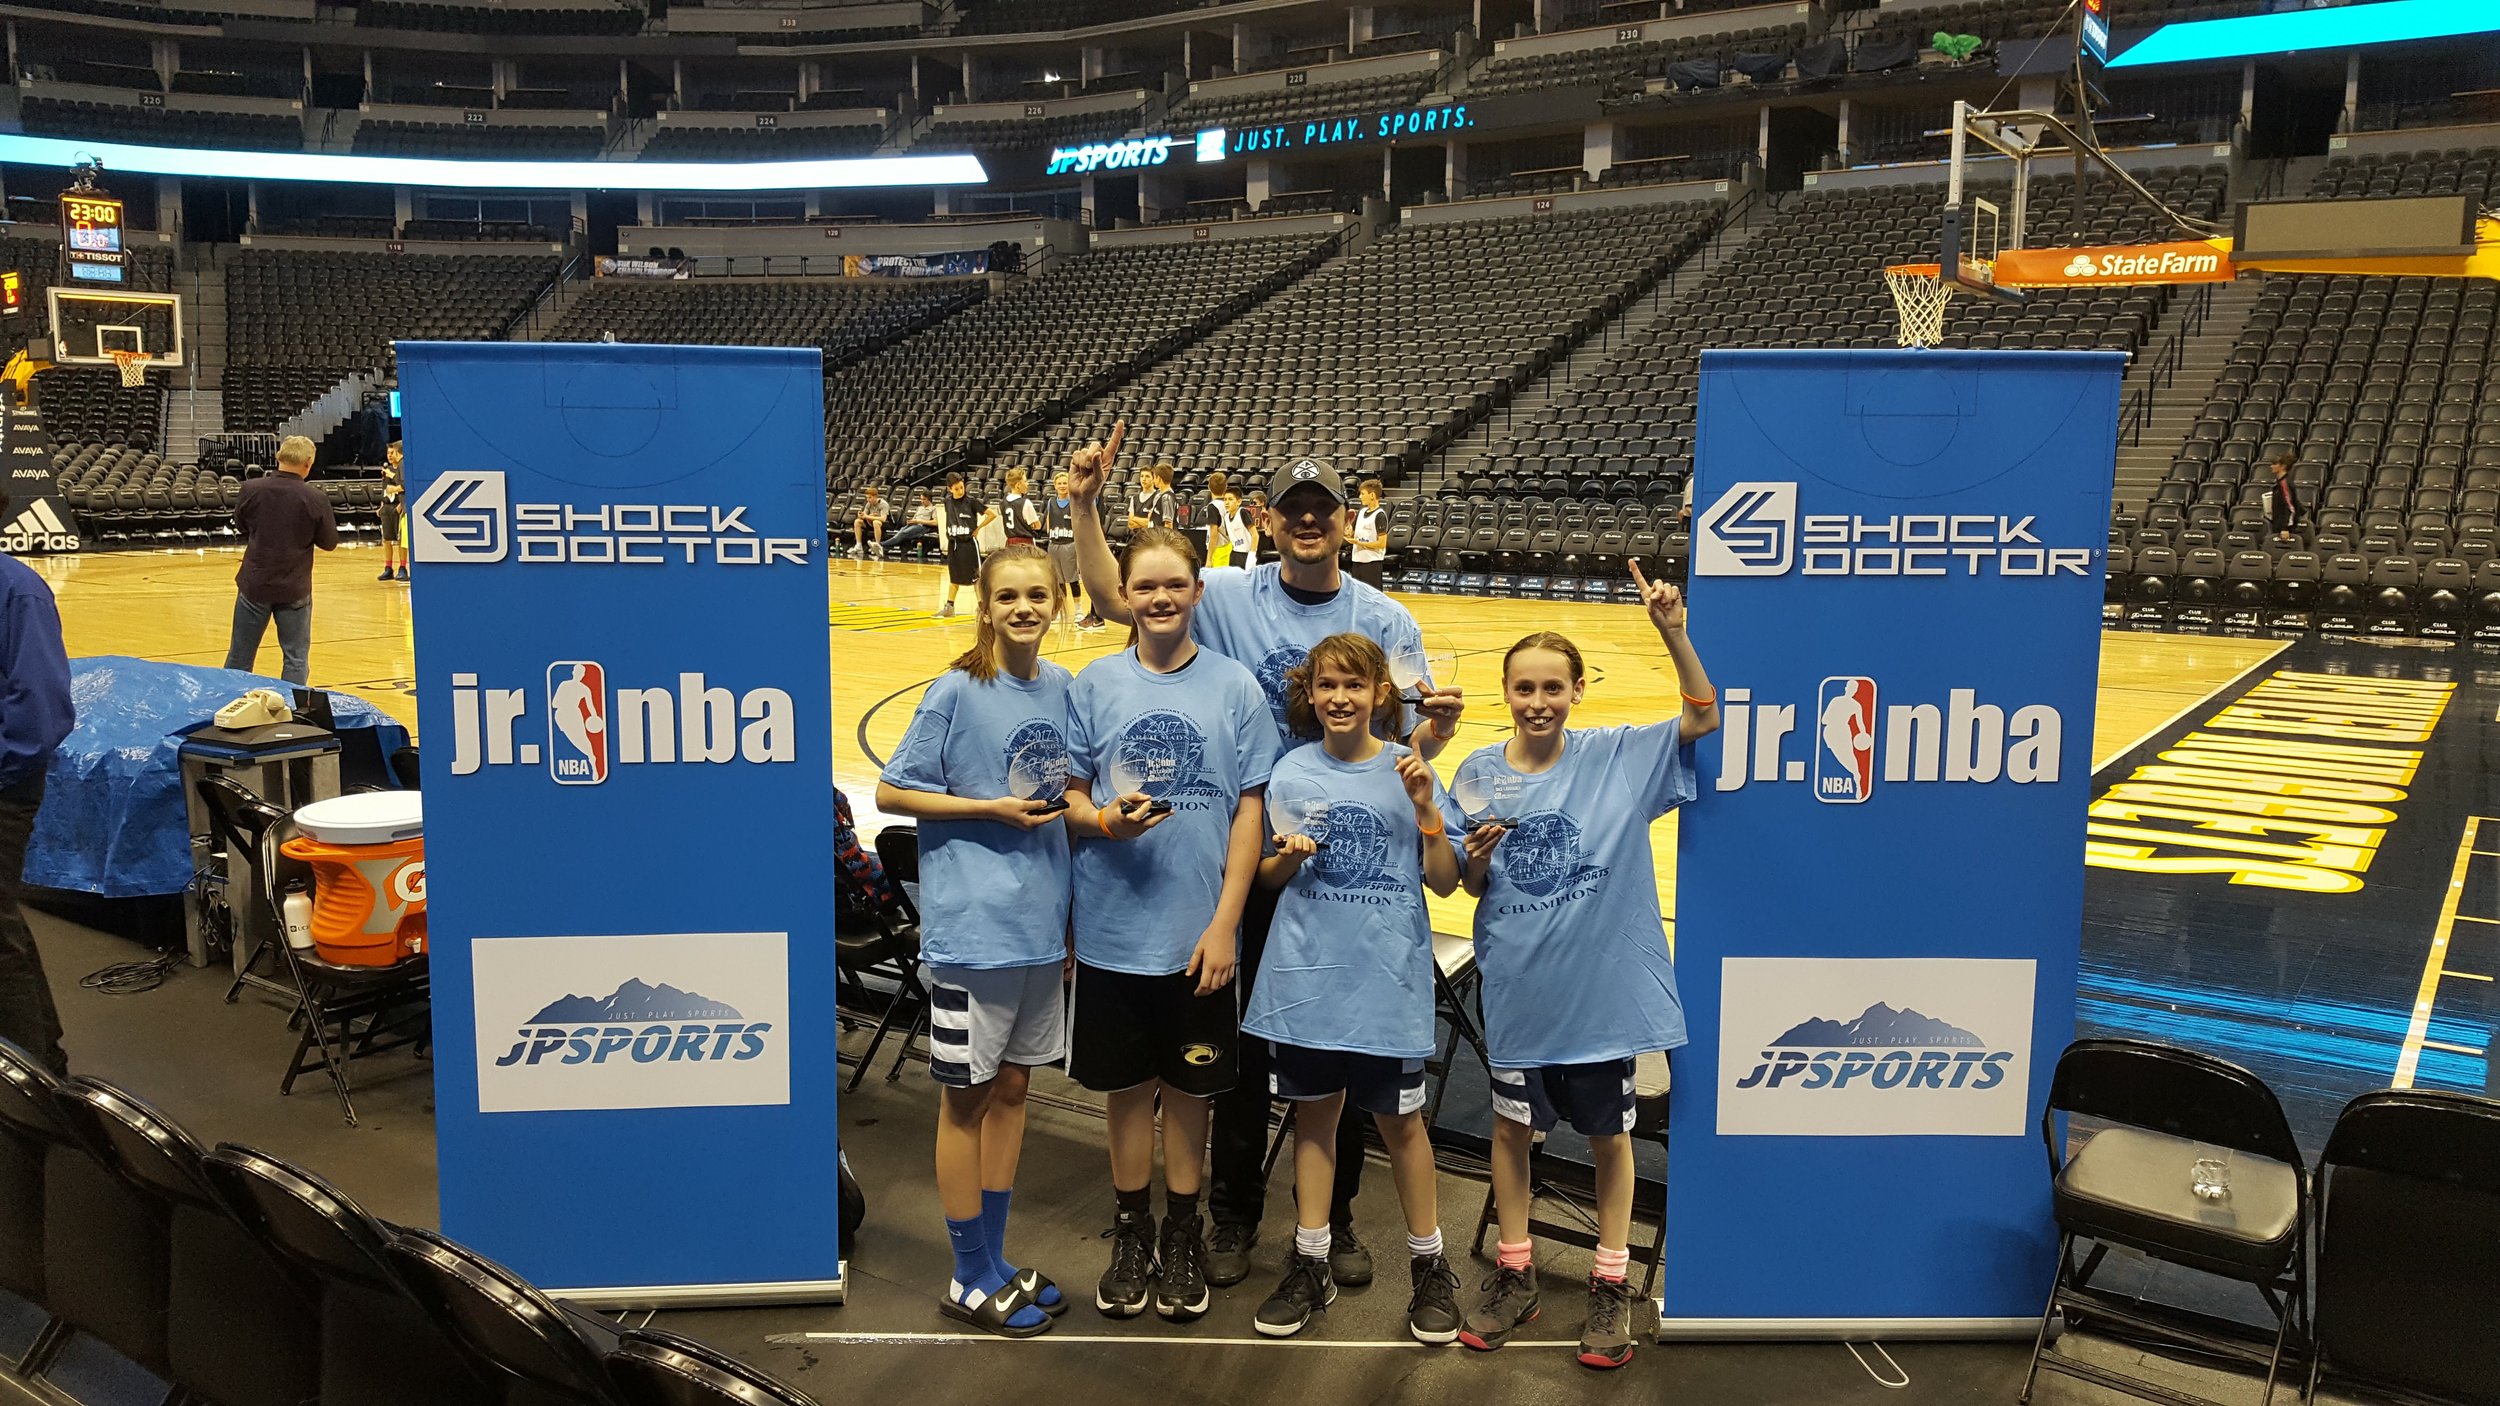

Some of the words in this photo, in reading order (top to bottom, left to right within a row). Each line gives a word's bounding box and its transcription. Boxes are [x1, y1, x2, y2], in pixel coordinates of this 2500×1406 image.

[1620, 30, 1638, 40] 230
[1289, 74, 1303, 84] 228
[143, 95, 161, 105] 220
[1027, 107, 1042, 115] 226
[759, 117, 774, 125] 224
[1234, 126, 1291, 153] JUST.
[1304, 119, 1365, 145] PLAY.
[1379, 105, 1476, 138] SPORTS.
[1046, 136, 1173, 176] JPSPORTS
[1536, 201, 1550, 209] 124
[70, 203, 115, 223] 23:00
[86, 253, 123, 262] TISSOT
[877, 256, 913, 267] PROTECT
[13, 424, 40, 433] AVAYA
[12, 447, 44, 457] AVAYA
[12, 469, 50, 480] AVAYA
[515, 503, 756, 533] SHOCK
[1005, 507, 1014, 530] 3
[1803, 515, 2043, 543] SHOCK
[0, 532, 80, 552] adidas
[450, 673, 541, 775] jr.
[617, 672, 796, 764] nba
[1144, 721, 1181, 733] 2017
[1025, 730, 1052, 743] 2017
[1715, 688, 1806, 792] jr.
[1885, 689, 2062, 784] nba
[558, 759, 590, 776] NBA
[1822, 777, 1854, 795] NBA
[1333, 812, 1367, 826] 2017
[2085, 732, 2425, 893] NUGGETS
[1299, 888, 1392, 906] CHAMPION
[1499, 885, 1598, 915] CHAMPION
[607, 1012, 640, 1020] JUST.
[495, 1022, 773, 1067] JPSPORTS
[1851, 1037, 1884, 1045] JUST.
[1735, 1050, 2014, 1090] JPSPORTS
